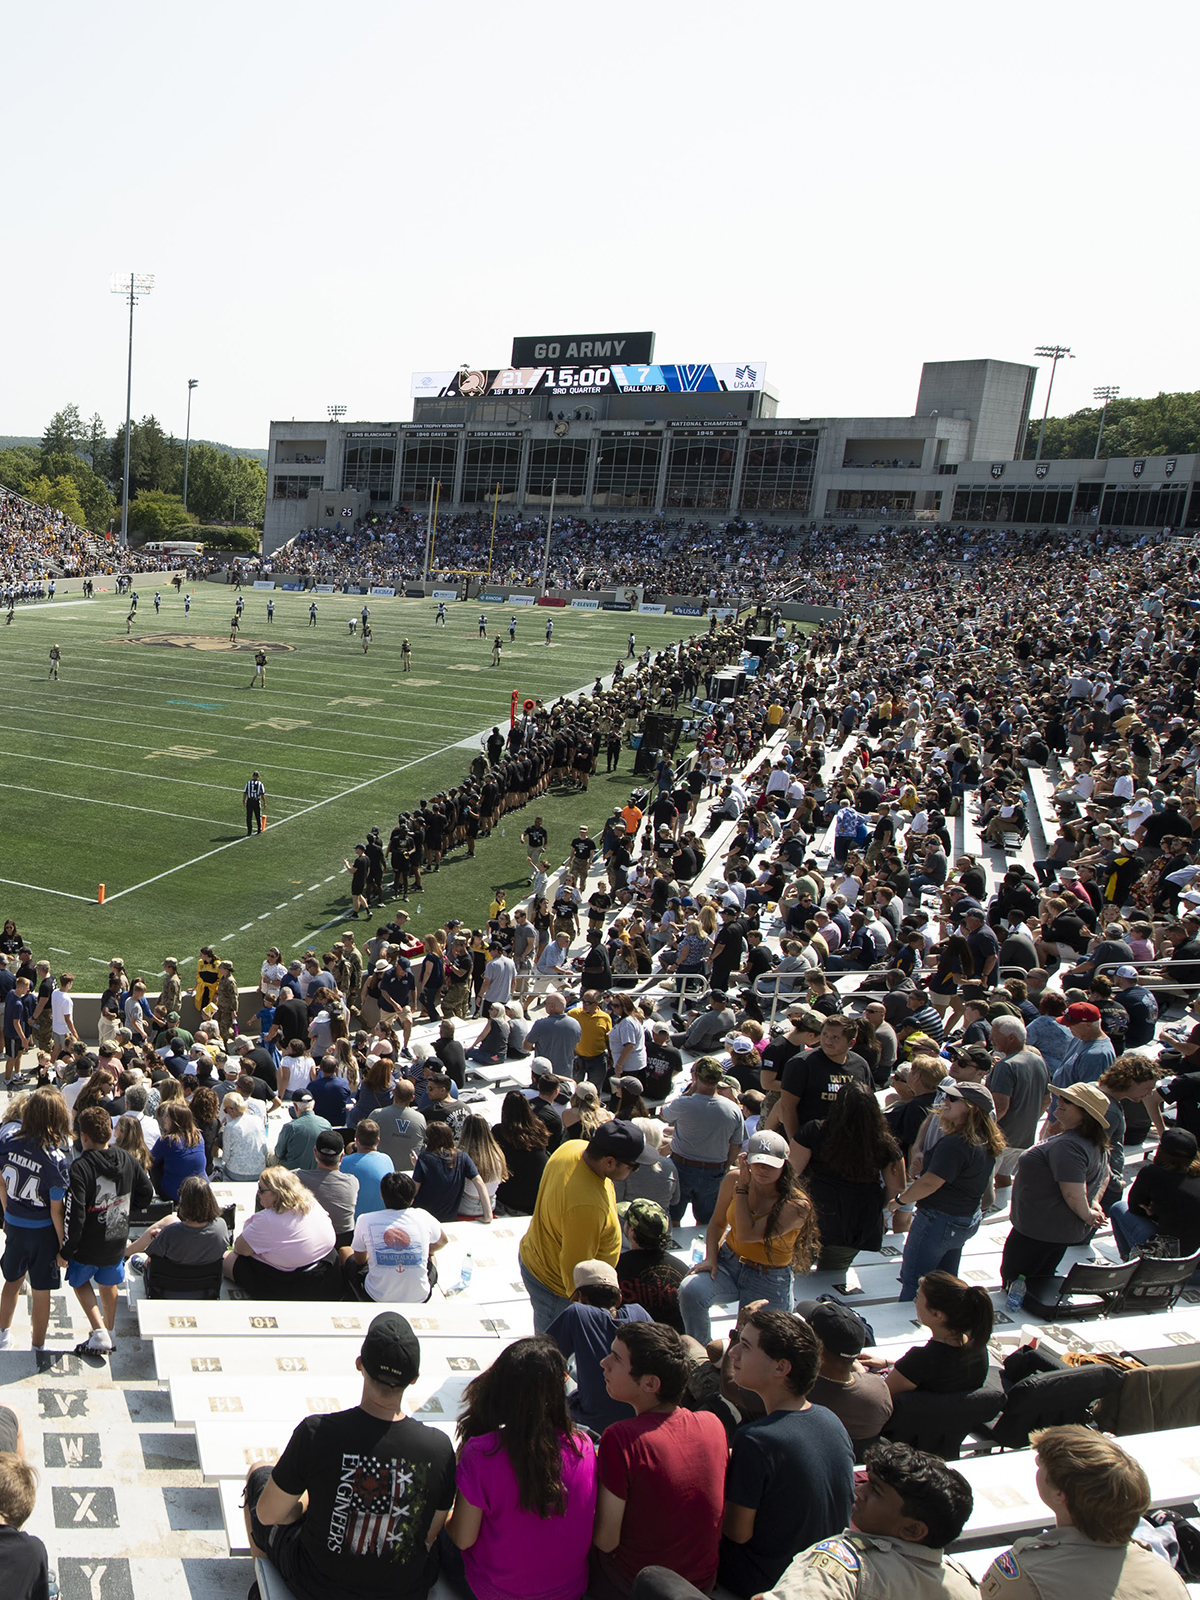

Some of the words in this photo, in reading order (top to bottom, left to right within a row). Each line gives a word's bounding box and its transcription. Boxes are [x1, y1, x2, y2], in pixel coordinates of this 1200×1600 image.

[534, 343, 561, 359] GO
[565, 340, 626, 358] ARMY
[501, 371, 524, 387] 21
[544, 368, 611, 387] 15:00
[637, 367, 651, 383] 7
[569, 386, 601, 394] QUARTER
[733, 381, 755, 389] USAA
[342, 508, 352, 516] 25
[244, 717, 312, 731] 20
[144, 745, 218, 760] 10
[830, 1074, 853, 1084] DUTY
[174, 1317, 191, 1328] 11
[253, 1317, 273, 1328] 10
[281, 1358, 302, 1371] 10
[54, 1393, 78, 1415] V
[60, 1437, 83, 1463] W
[70, 1492, 98, 1522] X
[326, 1453, 360, 1554] ENGINEERS
[80, 1565, 107, 1600] Y
